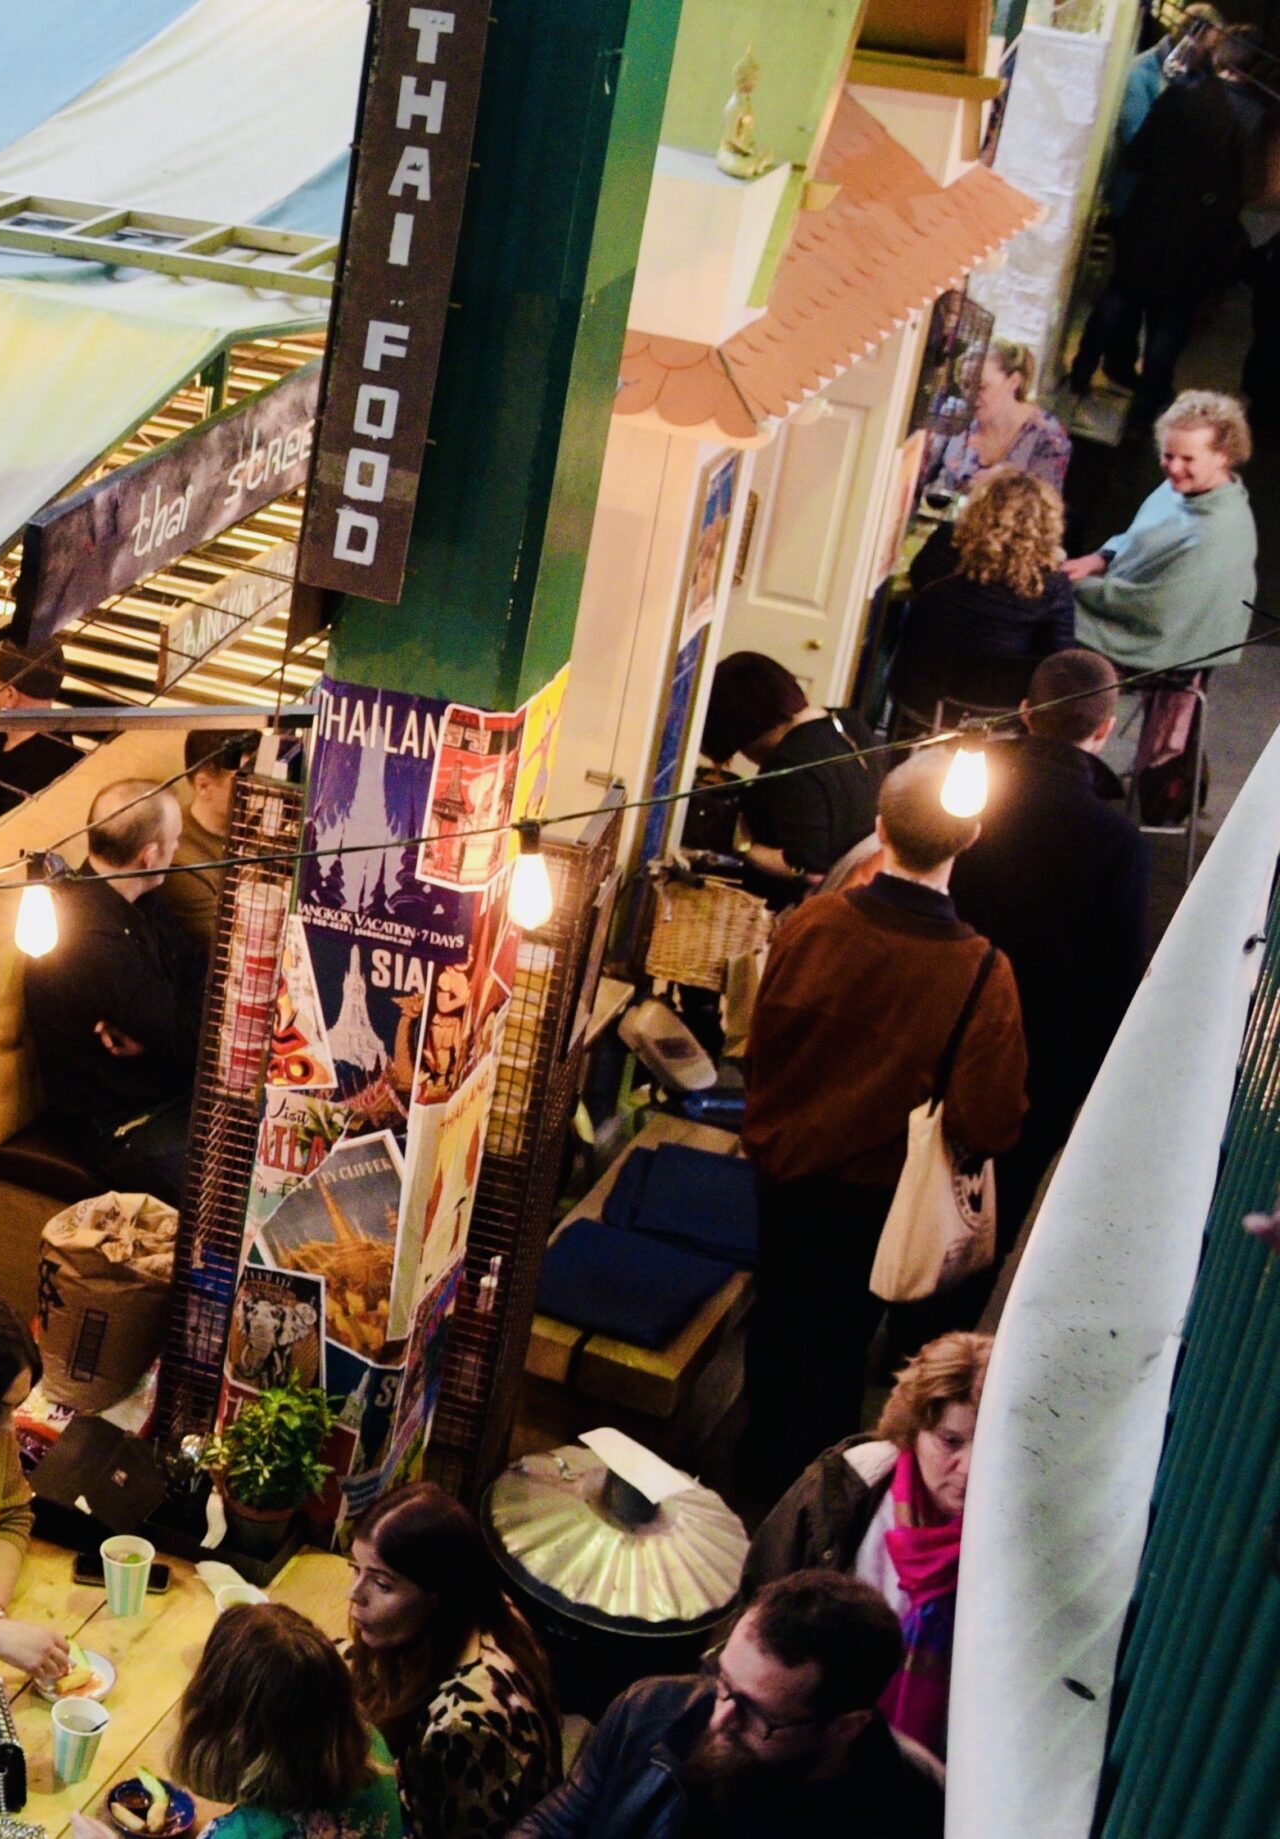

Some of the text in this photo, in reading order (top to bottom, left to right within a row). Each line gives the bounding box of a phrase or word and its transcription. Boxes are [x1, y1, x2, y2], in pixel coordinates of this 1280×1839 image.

[332, 7, 455, 567] THAI FOOD
[355, 911, 418, 939] VACATION
[421, 929, 429, 942] 7
[430, 930, 465, 949] DAYS
[270, 1097, 308, 1126] Visit
[339, 1157, 393, 1180] CLIPPER
